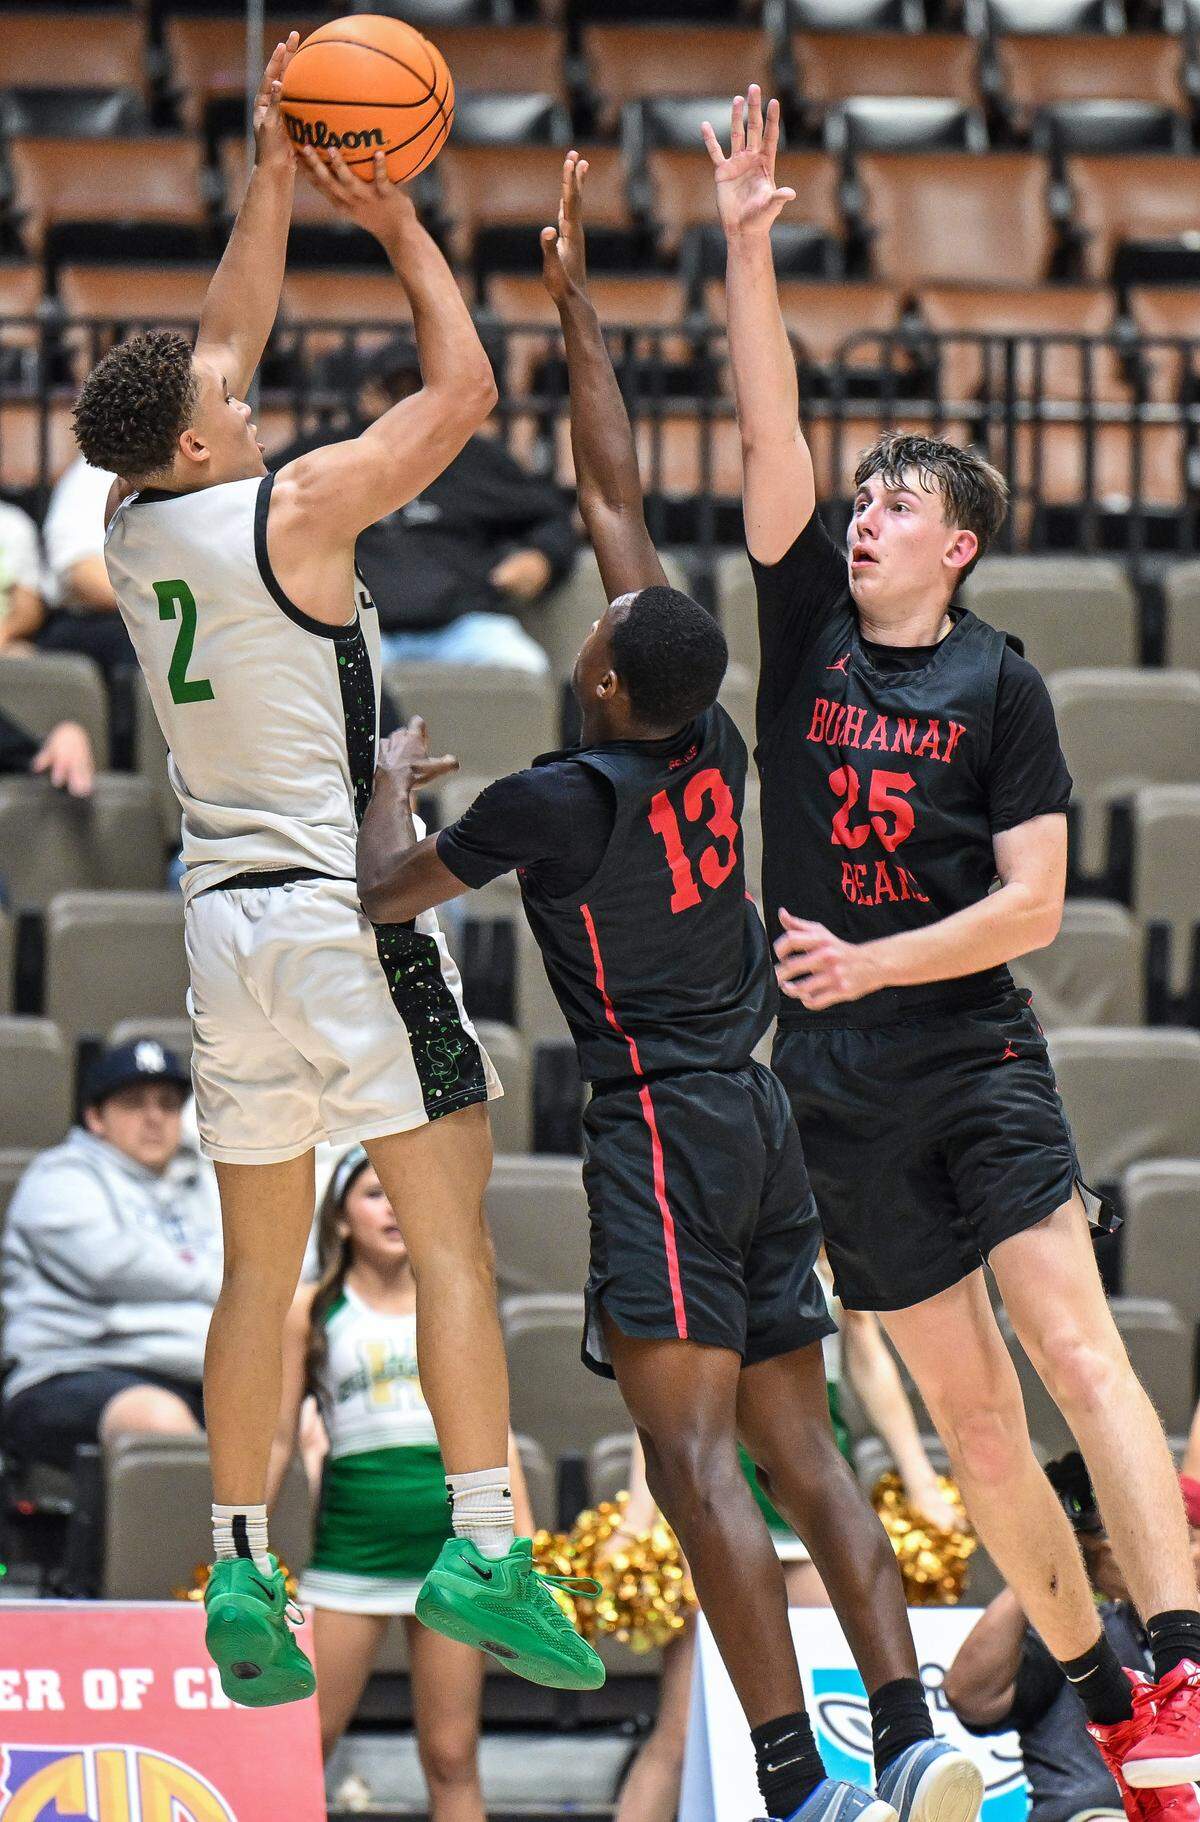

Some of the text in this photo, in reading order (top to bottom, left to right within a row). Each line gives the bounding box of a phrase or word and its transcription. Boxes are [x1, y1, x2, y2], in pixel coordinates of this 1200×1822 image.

[284, 111, 386, 149] Wilson
[152, 579, 215, 705] 2
[647, 767, 739, 915] 13
[828, 764, 918, 853] 25
[82, 1667, 155, 1711] OF
